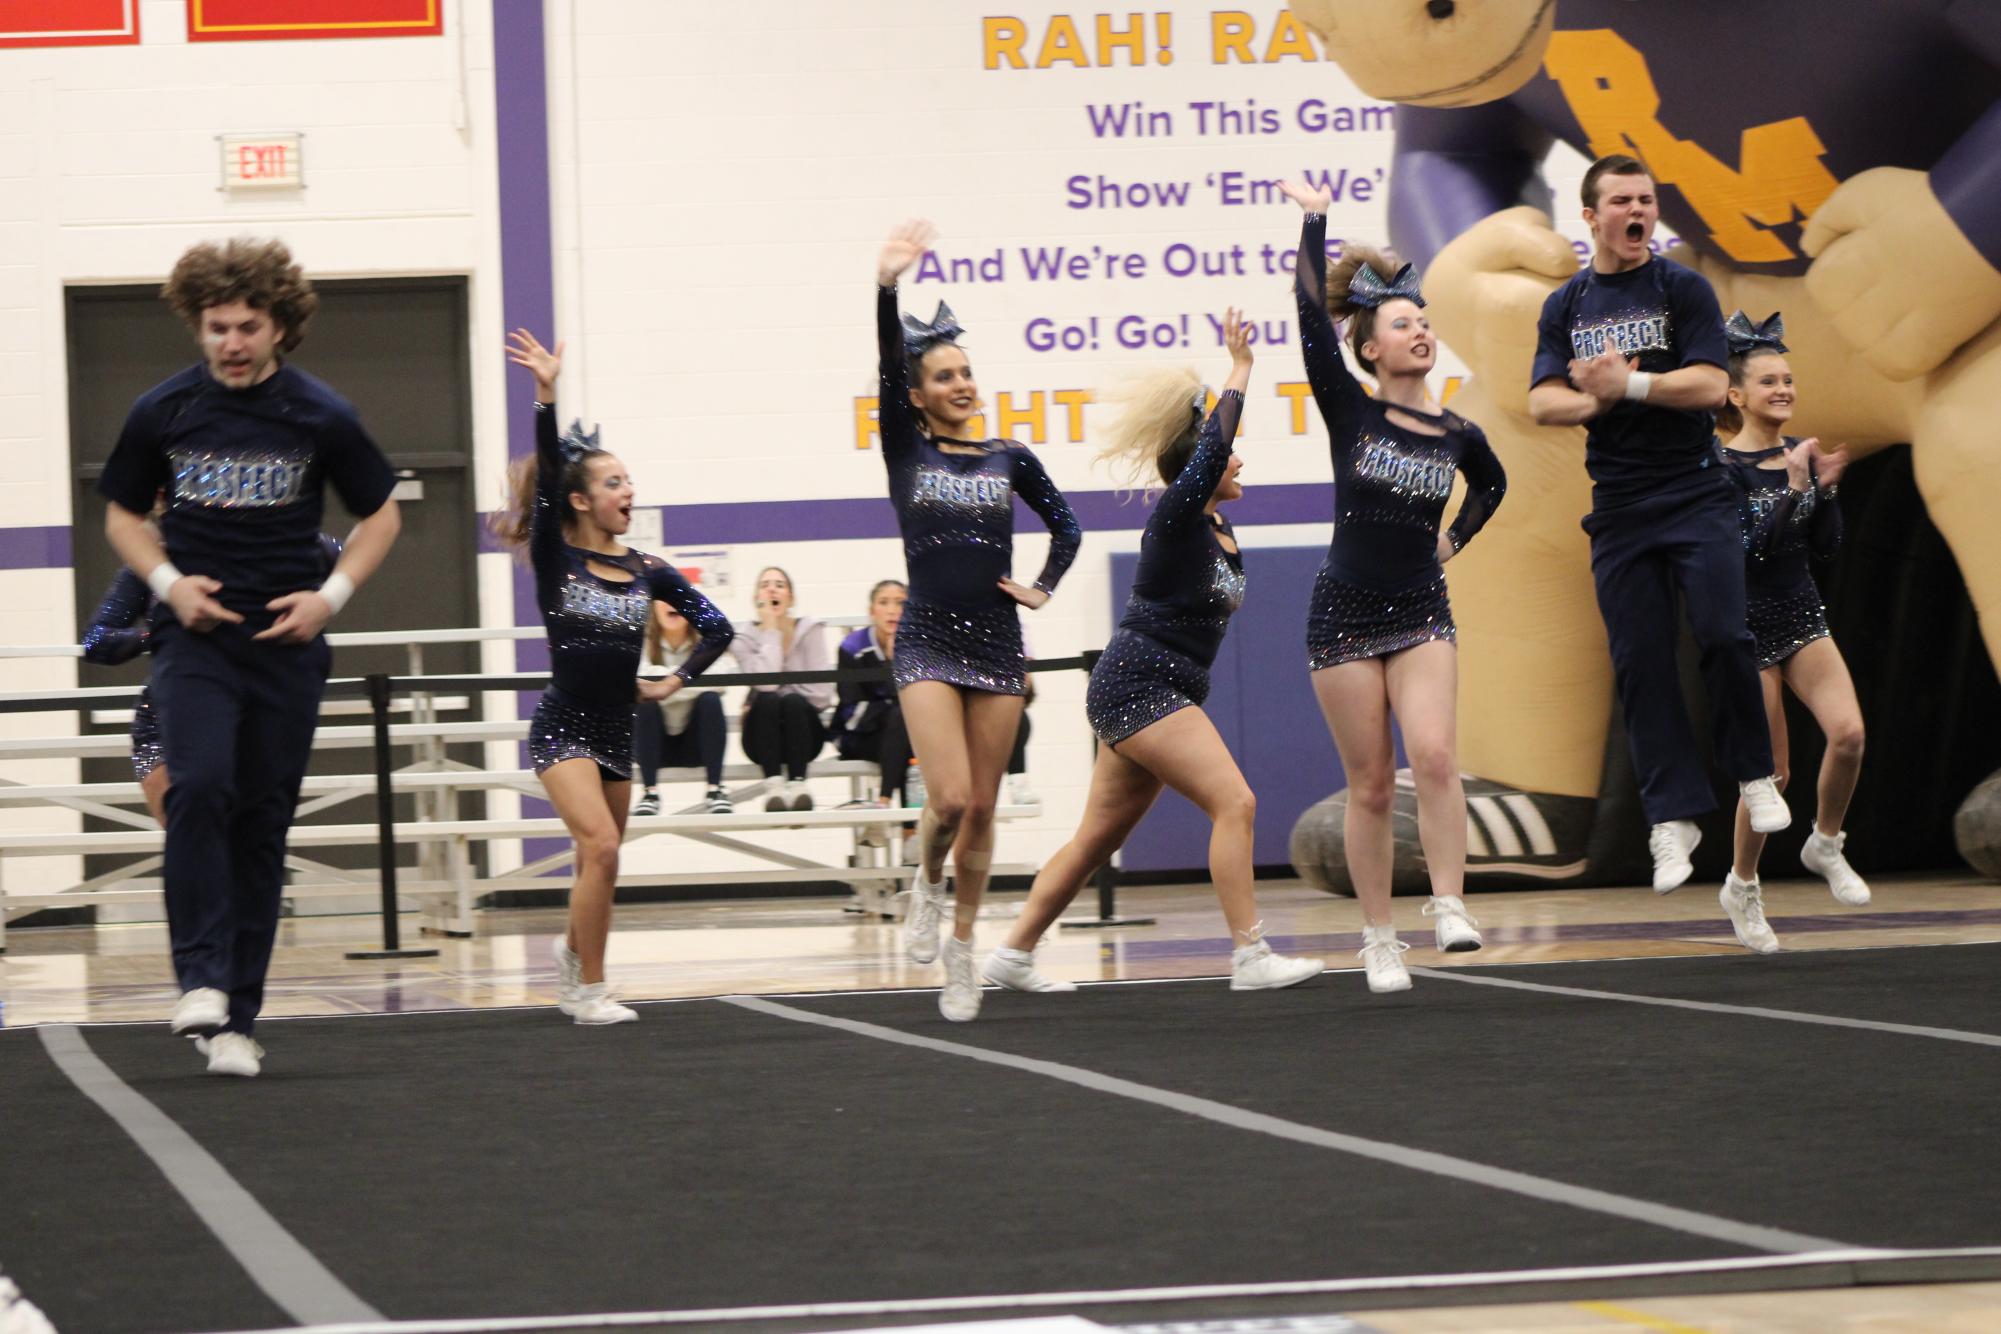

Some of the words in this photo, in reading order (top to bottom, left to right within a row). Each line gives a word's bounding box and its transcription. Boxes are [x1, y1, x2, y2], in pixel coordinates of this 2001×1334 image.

[982, 11, 1173, 70] RAH!
[1211, 9, 1336, 65] RA
[1086, 101, 1172, 138] Win
[1189, 99, 1280, 135] This
[240, 145, 288, 179] EXIT
[1066, 173, 1190, 210] Show
[914, 248, 1004, 283] And
[1163, 242, 1245, 277] Out
[1261, 243, 1298, 275] to
[1025, 316, 1099, 352] Go!
[1116, 314, 1190, 350] Go!
[1206, 312, 1288, 347] You
